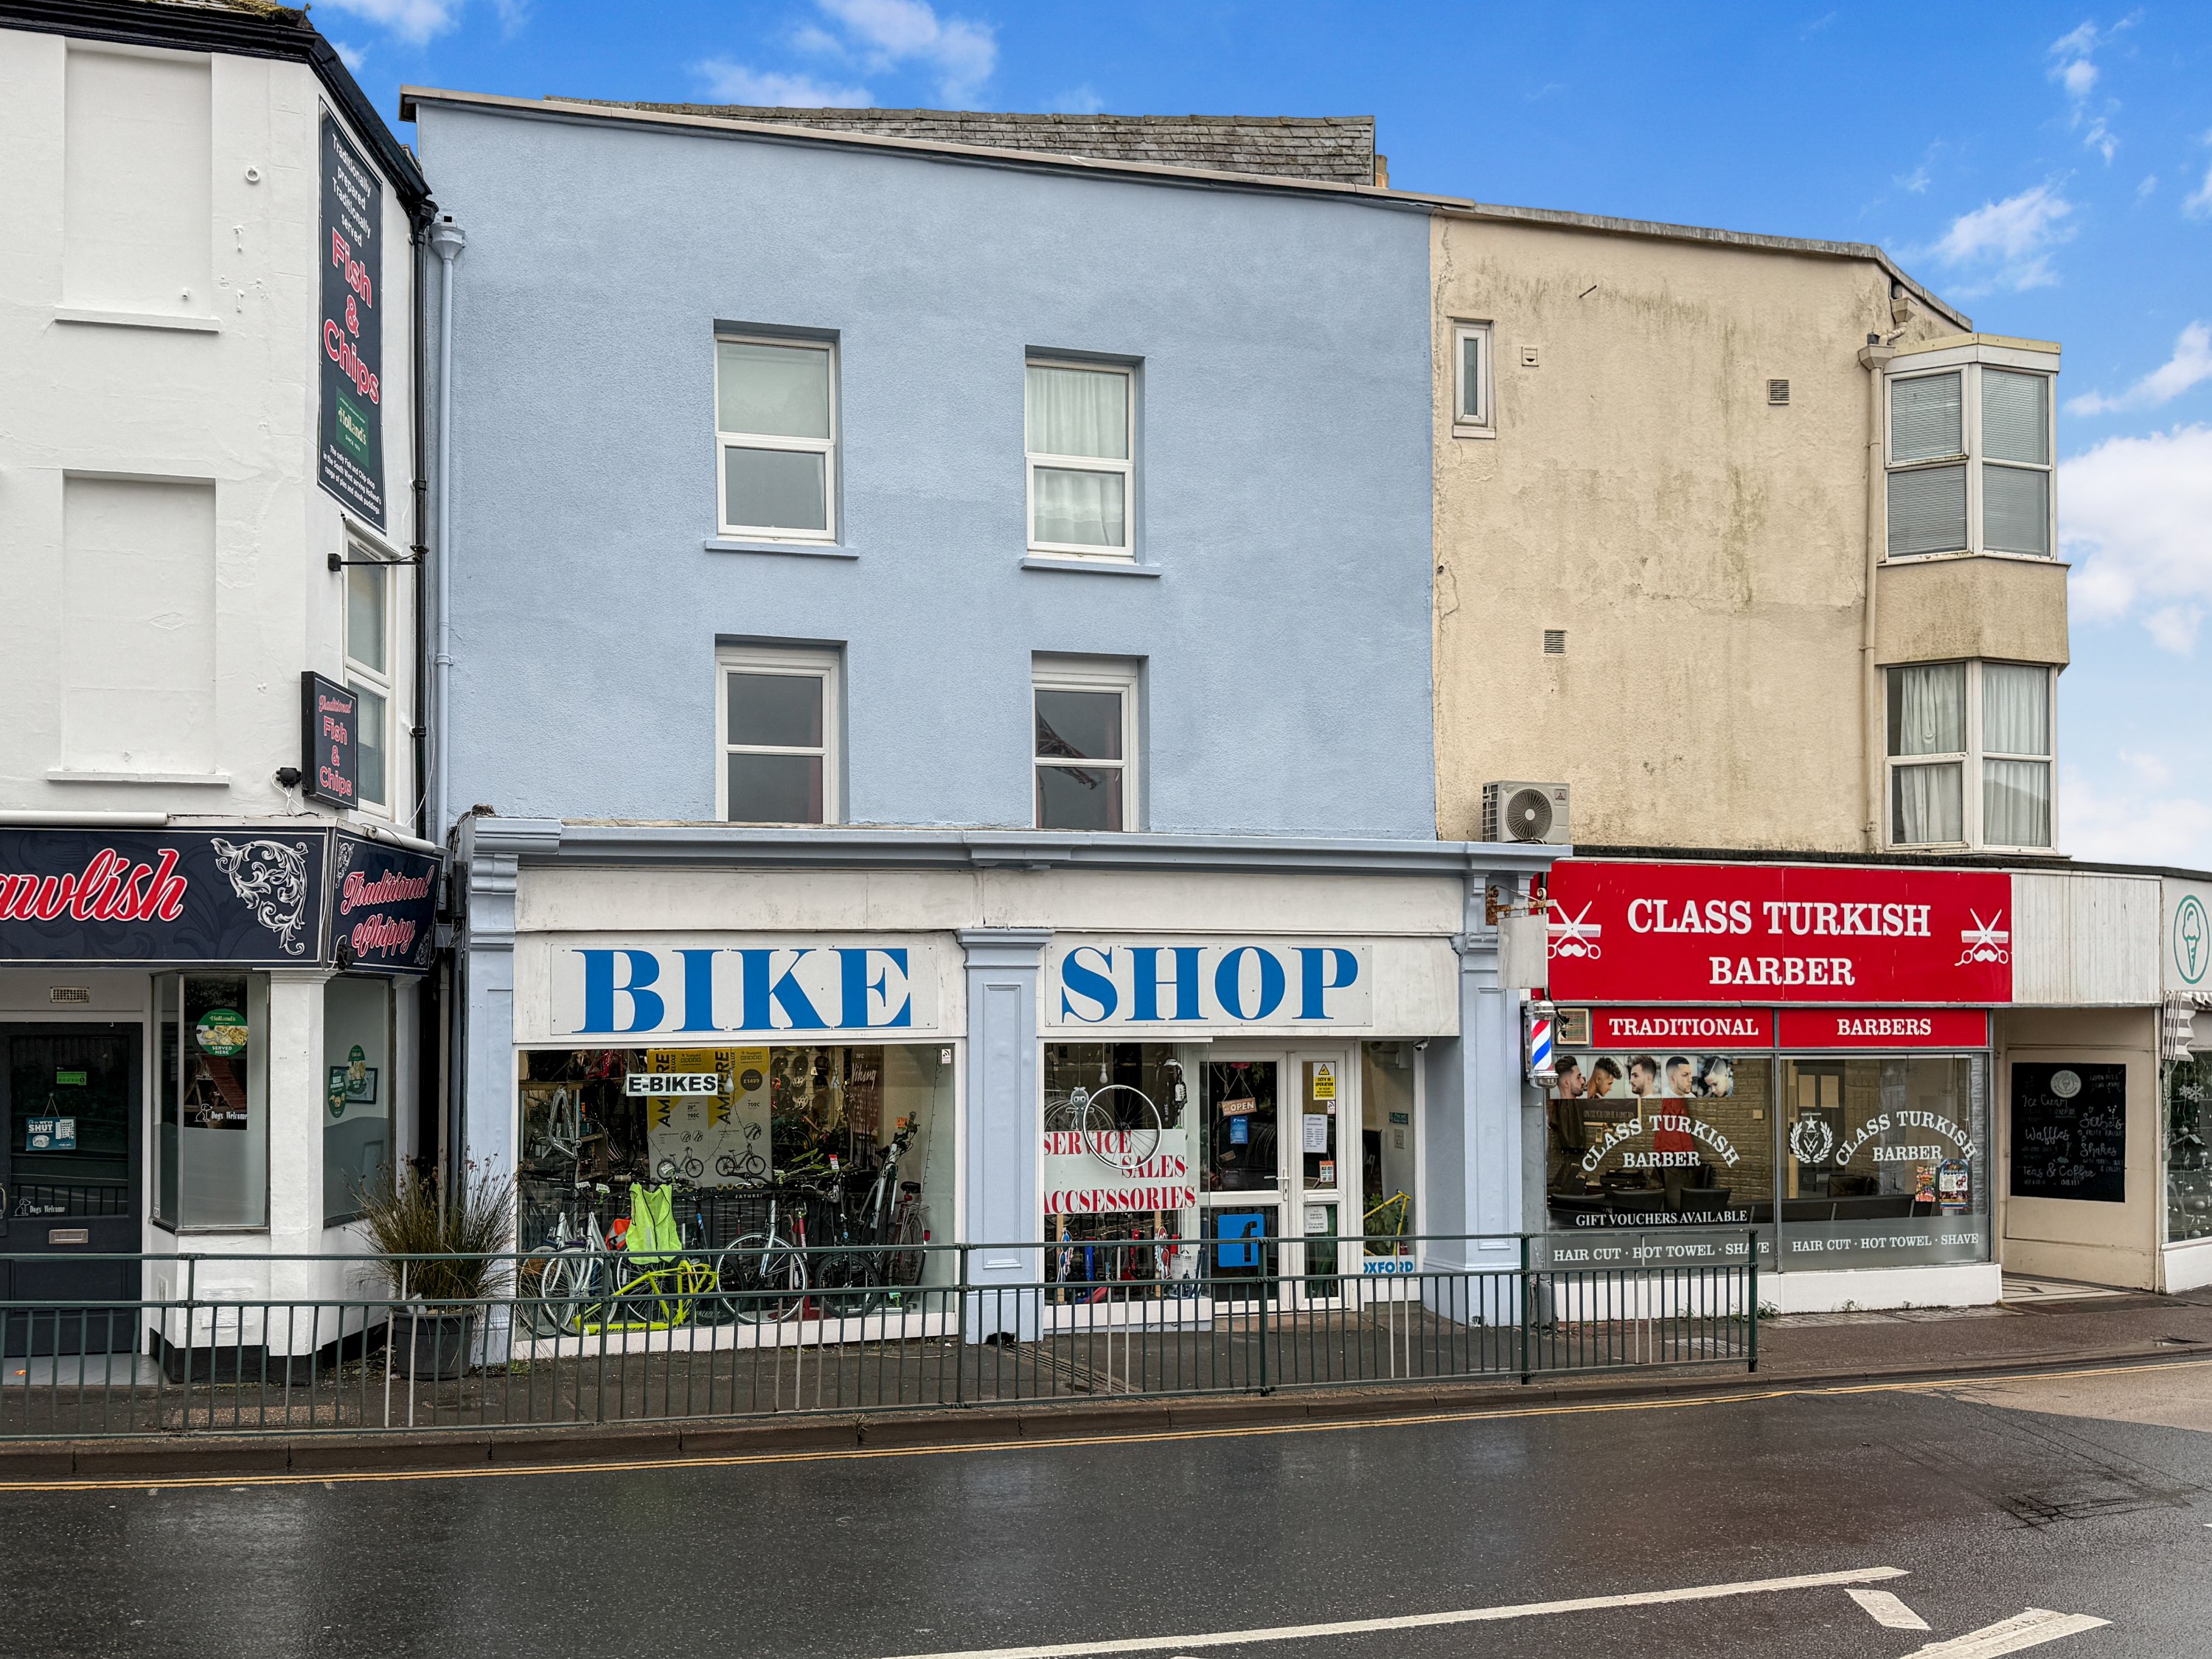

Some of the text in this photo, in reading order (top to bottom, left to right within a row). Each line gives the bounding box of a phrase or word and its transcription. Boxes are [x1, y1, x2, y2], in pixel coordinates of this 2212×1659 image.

[333, 133, 371, 198] Traditionally
[338, 165, 366, 211] prepared
[333, 177, 371, 239] Traditionally
[341, 214, 362, 248] served
[332, 226, 372, 308] Fish
[346, 295, 360, 338] &
[324, 319, 378, 404] Chips
[323, 715, 347, 745] Fish
[331, 745, 340, 767] &
[319, 766, 352, 796] Chips
[341, 865, 434, 915] Traditional
[1627, 899, 1931, 936] CLASS TURKISH
[352, 914, 415, 958] Chippy
[1709, 956, 1855, 986] BARBER
[571, 946, 1358, 1033] BIKE SHOP
[1609, 1018, 1931, 1037] TRADITIONAL BARBERS
[629, 1076, 716, 1092] E-BIKES
[212, 1111, 248, 1121] Dogs Welcome
[1231, 1102, 1254, 1111] OPEN
[1044, 1130, 1132, 1155] SERVICE
[1582, 1114, 1740, 1172] CLASS TURKISH
[1835, 1110, 1978, 1166] CLASS TURKISH
[2025, 1127, 2070, 1144] Waffles
[2080, 1142, 2117, 1158] Shakes
[1121, 1155, 1186, 1178] SALES
[1623, 1152, 1701, 1168] BARBER
[1872, 1145, 1943, 1162] BARBER
[30, 1205, 65, 1214] Dogs Welcome
[1576, 1210, 1747, 1226] GIFT VOUCHERS AVAILABLE
[1554, 1248, 1589, 1262] HAIR
[1593, 1248, 1621, 1260] CUT
[1632, 1246, 1662, 1259] HOT
[1666, 1244, 1715, 1257] TOWEL
[1792, 1234, 1979, 1252] HAIR CUT HOT TOWEL SHAVE
